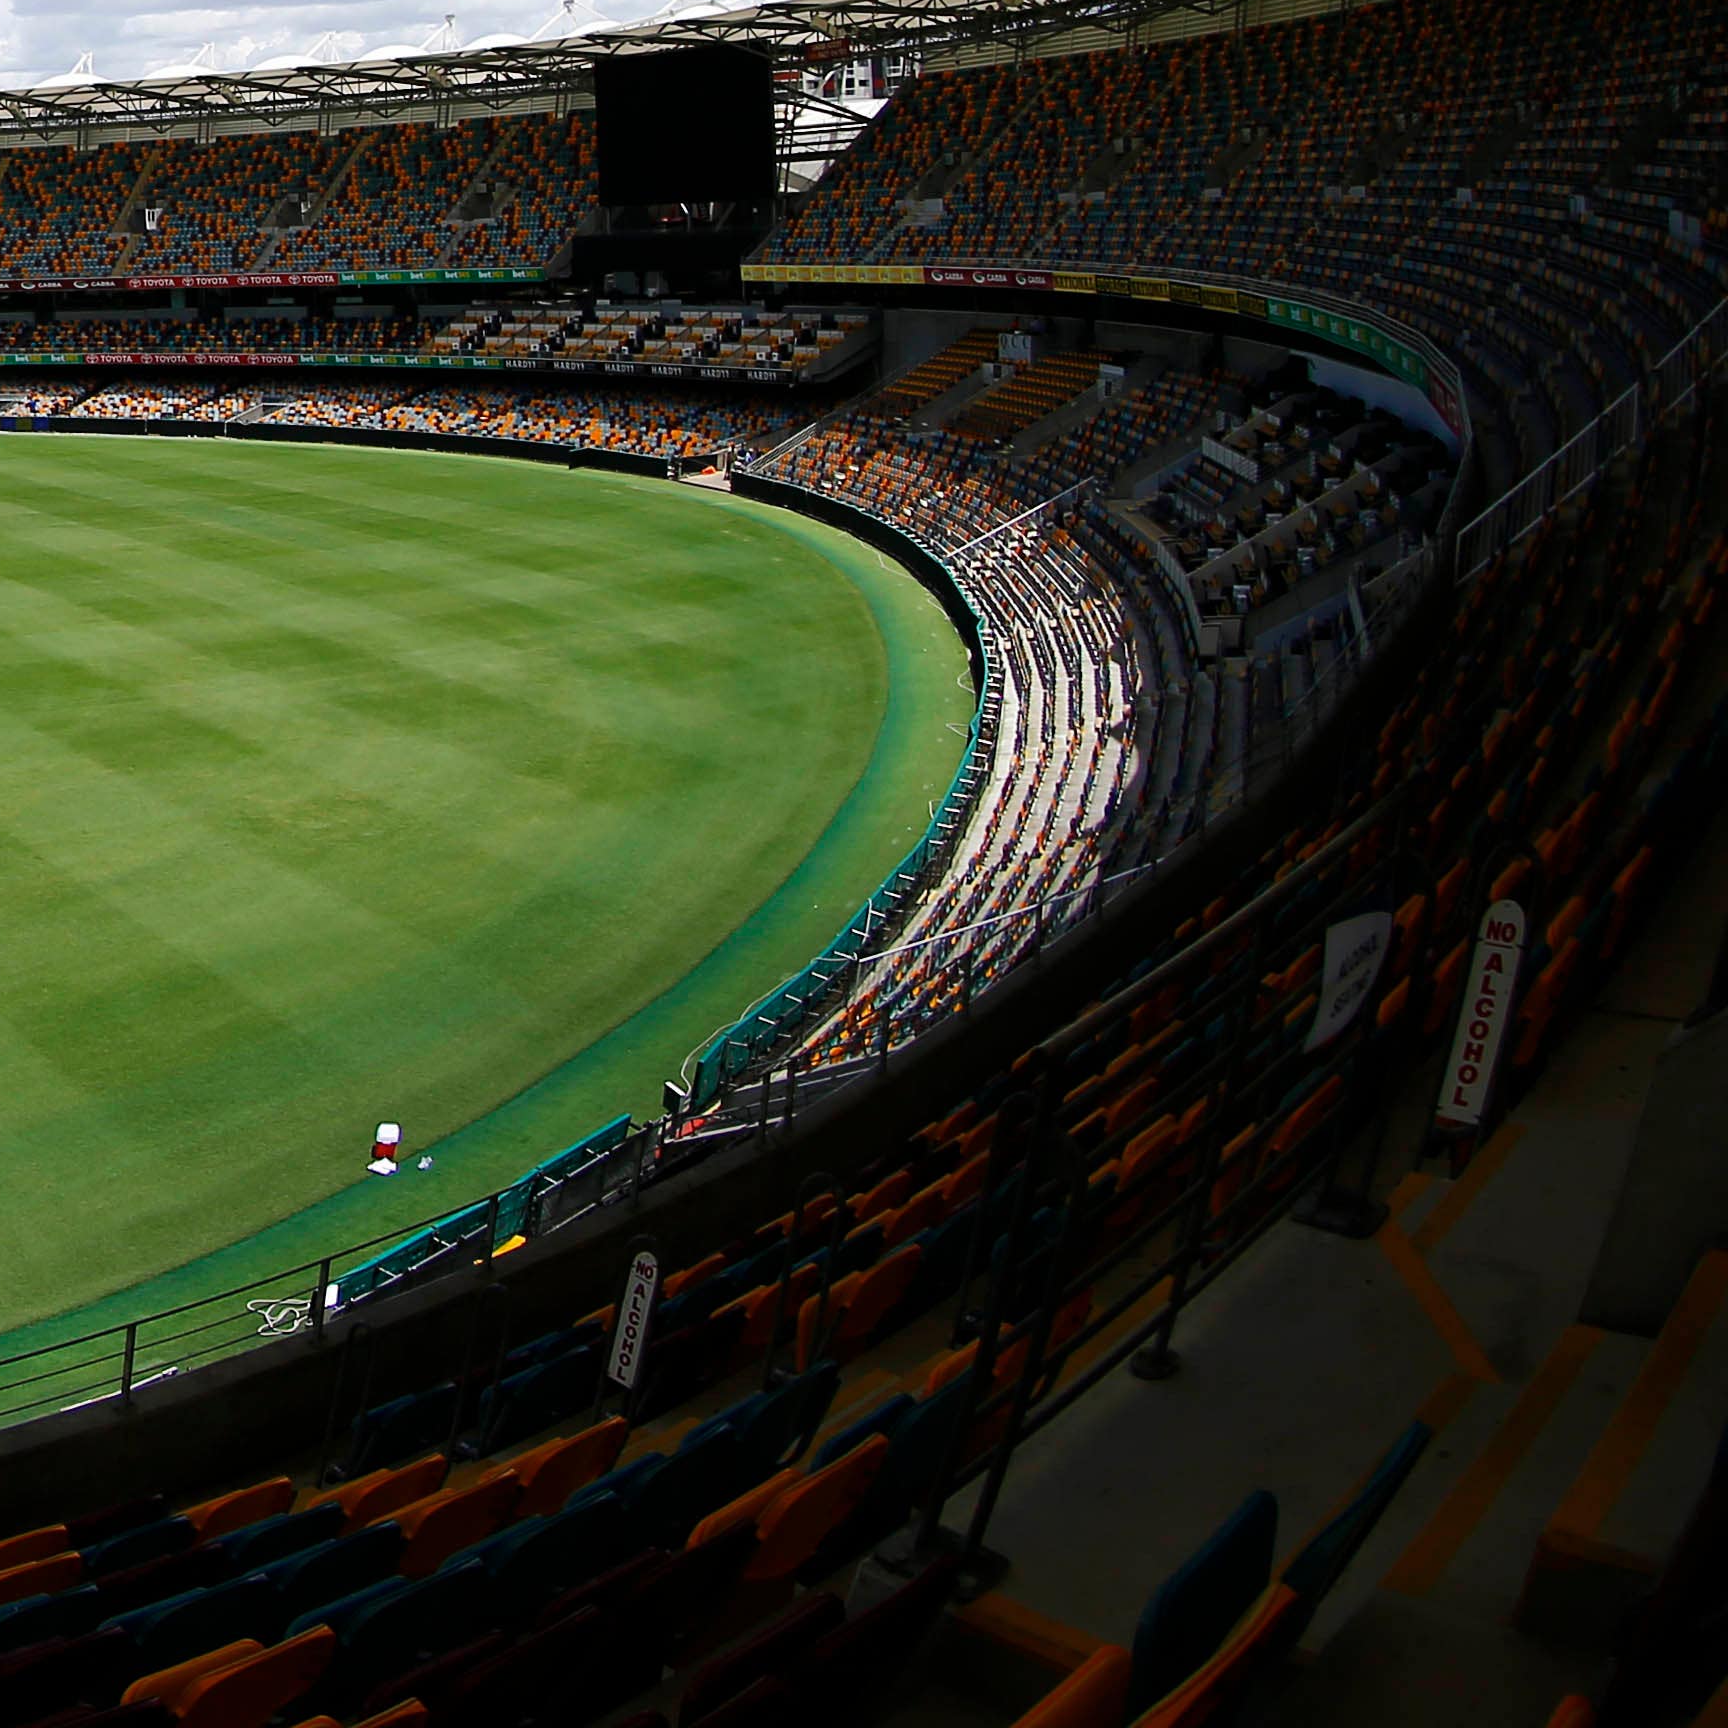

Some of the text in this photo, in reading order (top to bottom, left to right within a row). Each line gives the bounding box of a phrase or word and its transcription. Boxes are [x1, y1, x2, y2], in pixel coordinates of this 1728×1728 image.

[143, 278, 175, 287] TOYOTA
[196, 277, 228, 285] TOYOTA
[250, 276, 281, 284] TOYOTA
[302, 275, 334, 283] TOYOTA
[51, 354, 78, 362] bet
[100, 355, 133, 363] TOYOTA
[155, 355, 187, 363] TOYOTA
[208, 355, 240, 364] TOYOTA
[261, 355, 293, 363] TOYOTA
[300, 355, 327, 363] bet
[336, 355, 362, 363] bet
[370, 356, 396, 364] bet
[405, 357, 431, 365] bet
[1453, 921, 1516, 1107] NO ALCOHOL
[616, 1261, 653, 1381] NO ALCOHOL
